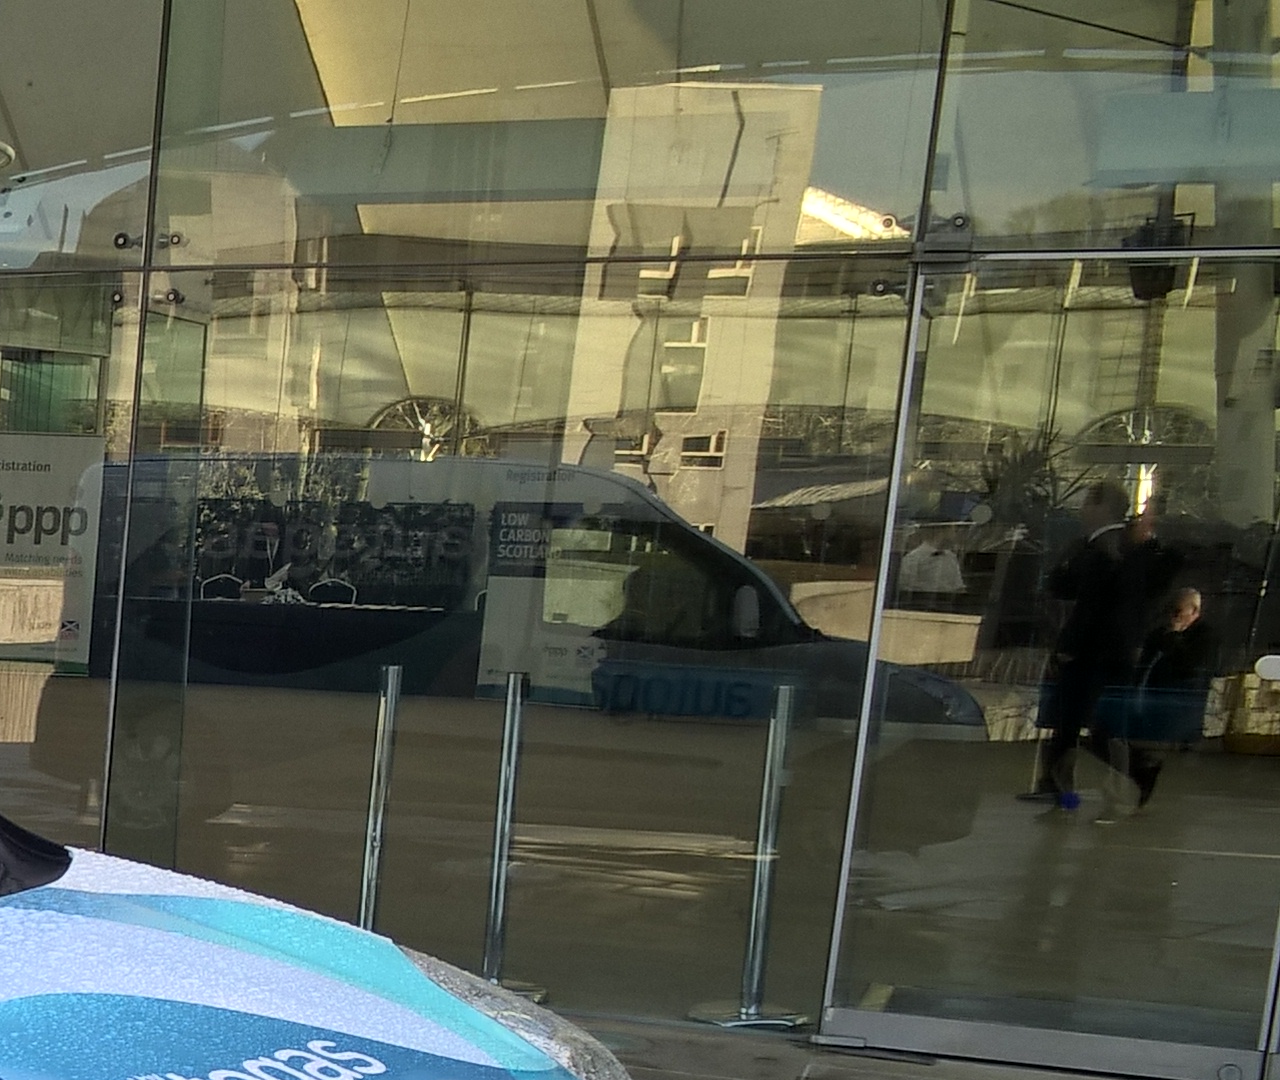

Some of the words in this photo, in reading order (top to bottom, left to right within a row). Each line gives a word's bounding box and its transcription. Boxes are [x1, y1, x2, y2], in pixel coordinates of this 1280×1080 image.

[501, 513, 529, 526] LOW
[499, 529, 550, 543] CARBON
[5, 552, 50, 566] Matching
